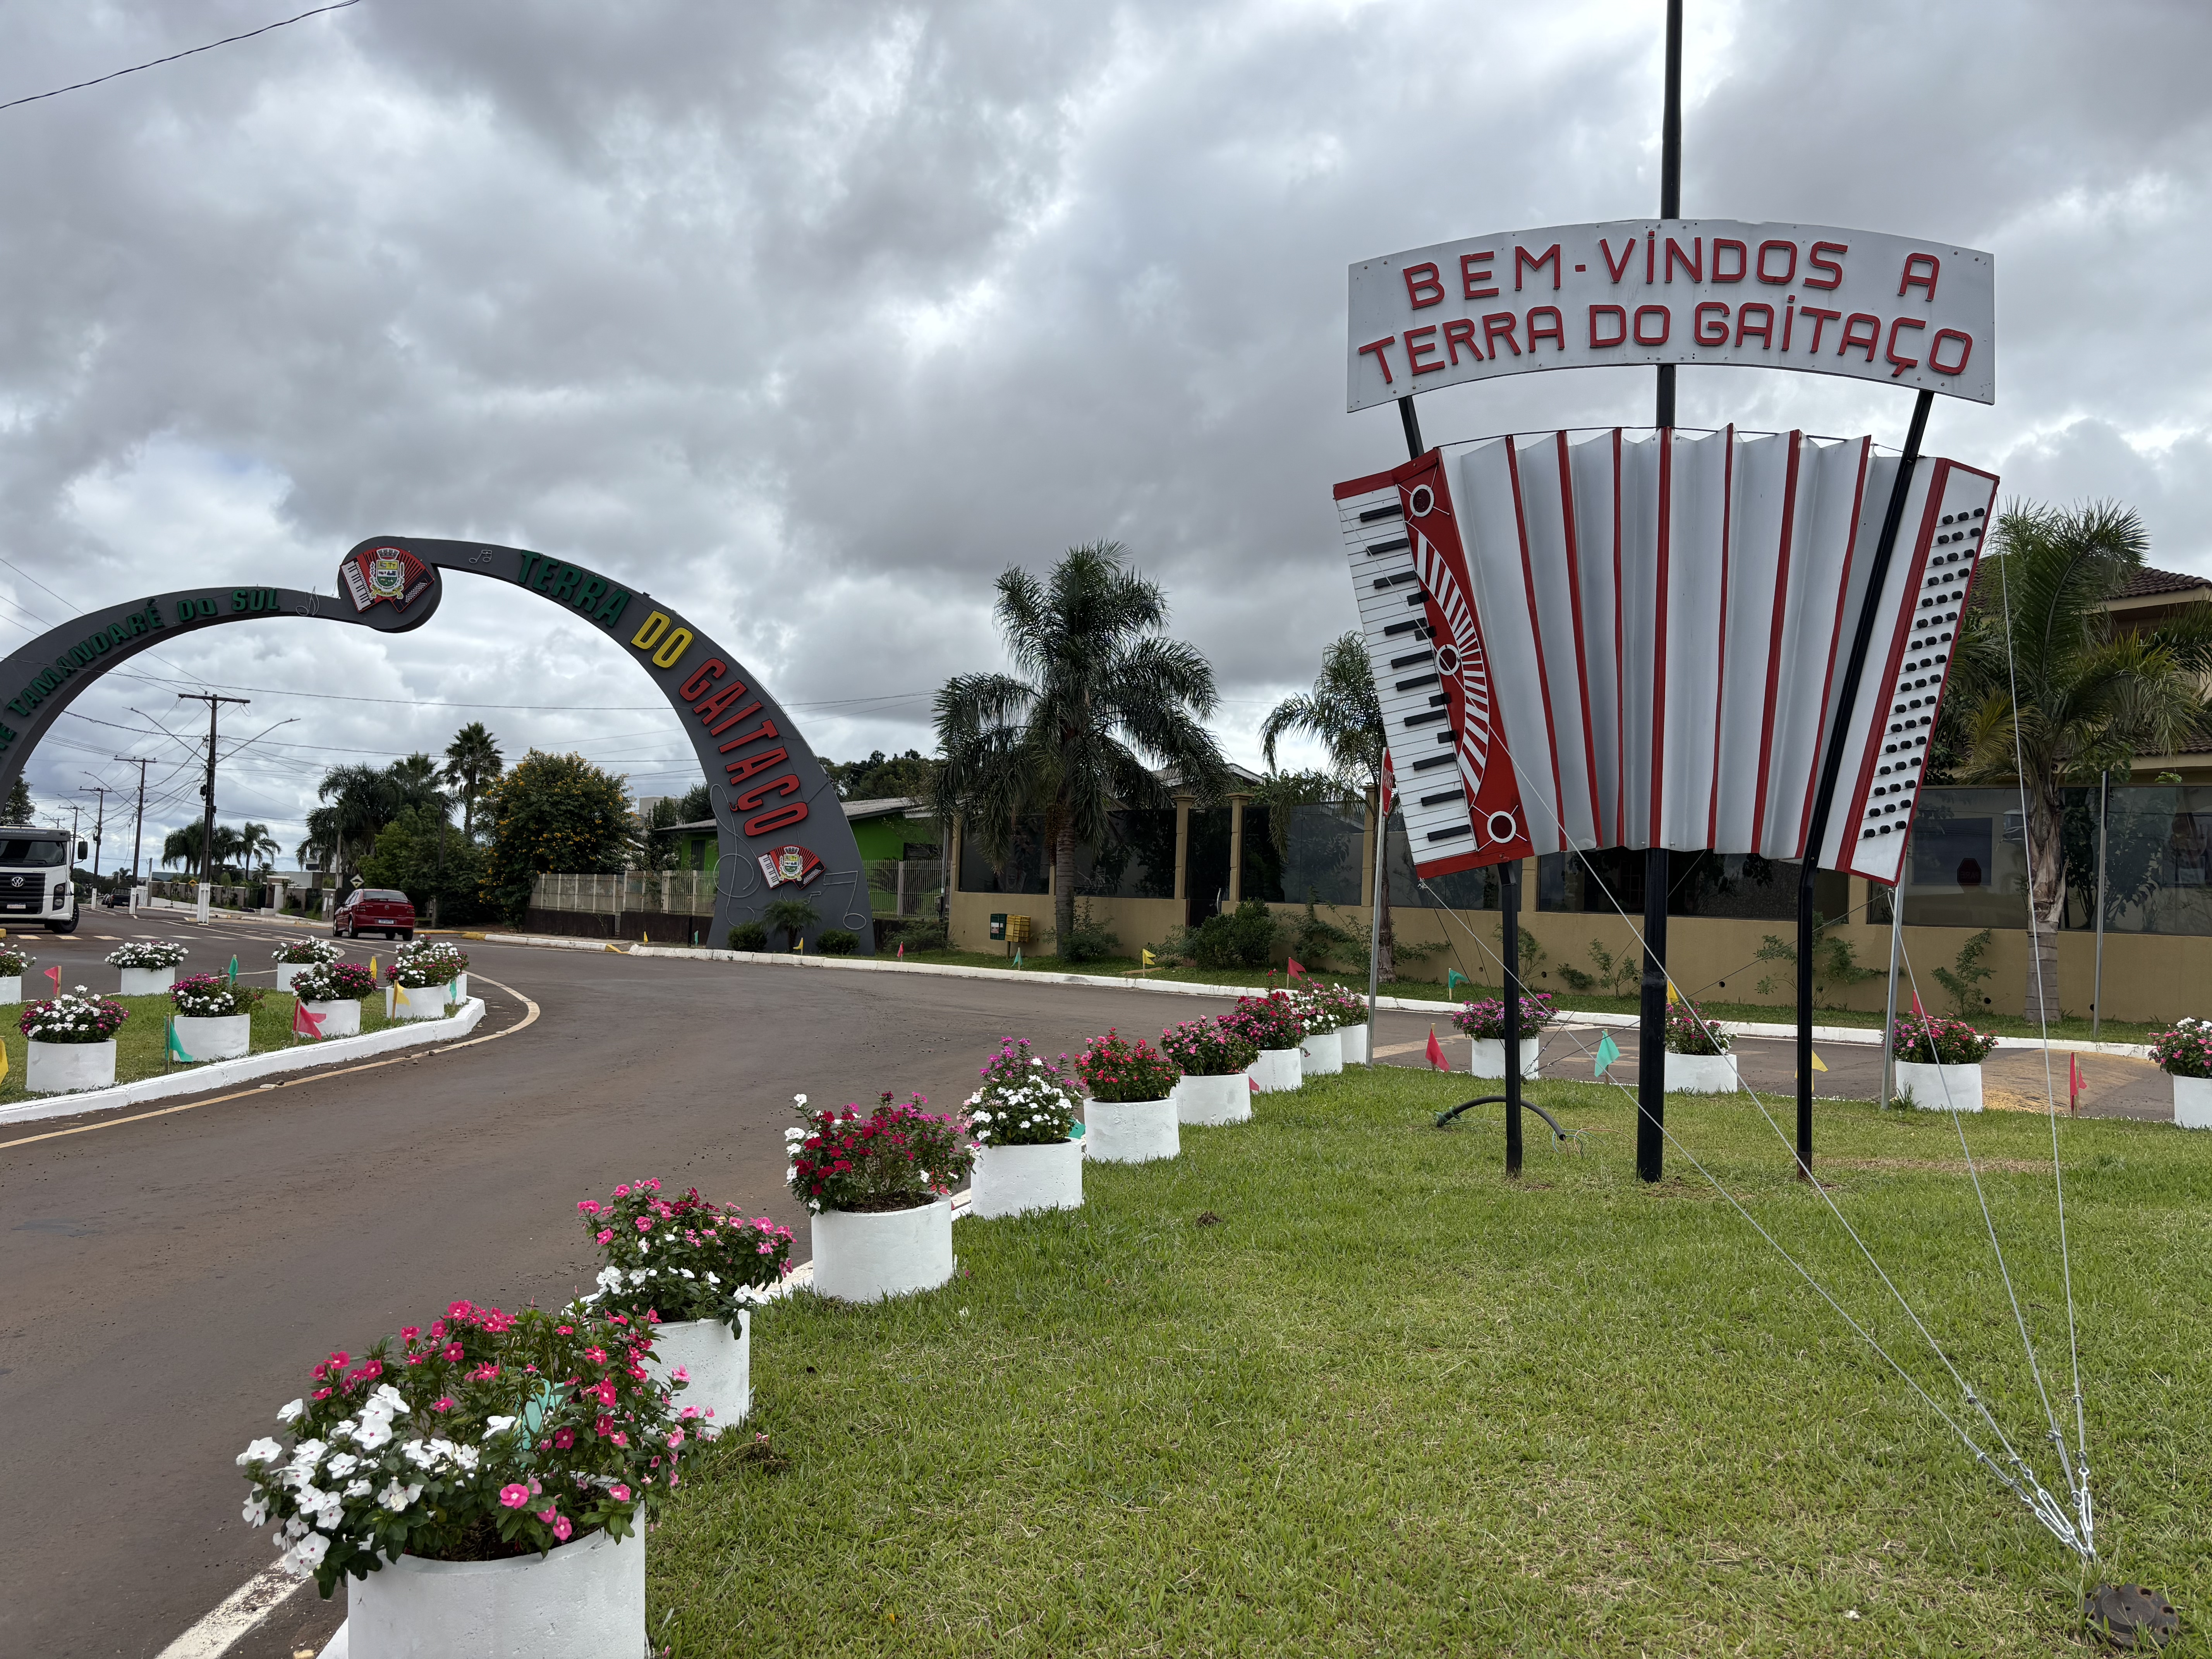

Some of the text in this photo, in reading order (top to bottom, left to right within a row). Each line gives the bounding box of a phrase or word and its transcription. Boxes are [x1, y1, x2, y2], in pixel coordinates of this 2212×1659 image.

[1898, 253, 1940, 301] A
[1358, 306, 1566, 383] TERRA
[1589, 304, 1671, 347] DO
[6, 588, 280, 716] TAMANDARÉ DO SUL
[517, 550, 809, 837] TERRA DO GAITAÇO
